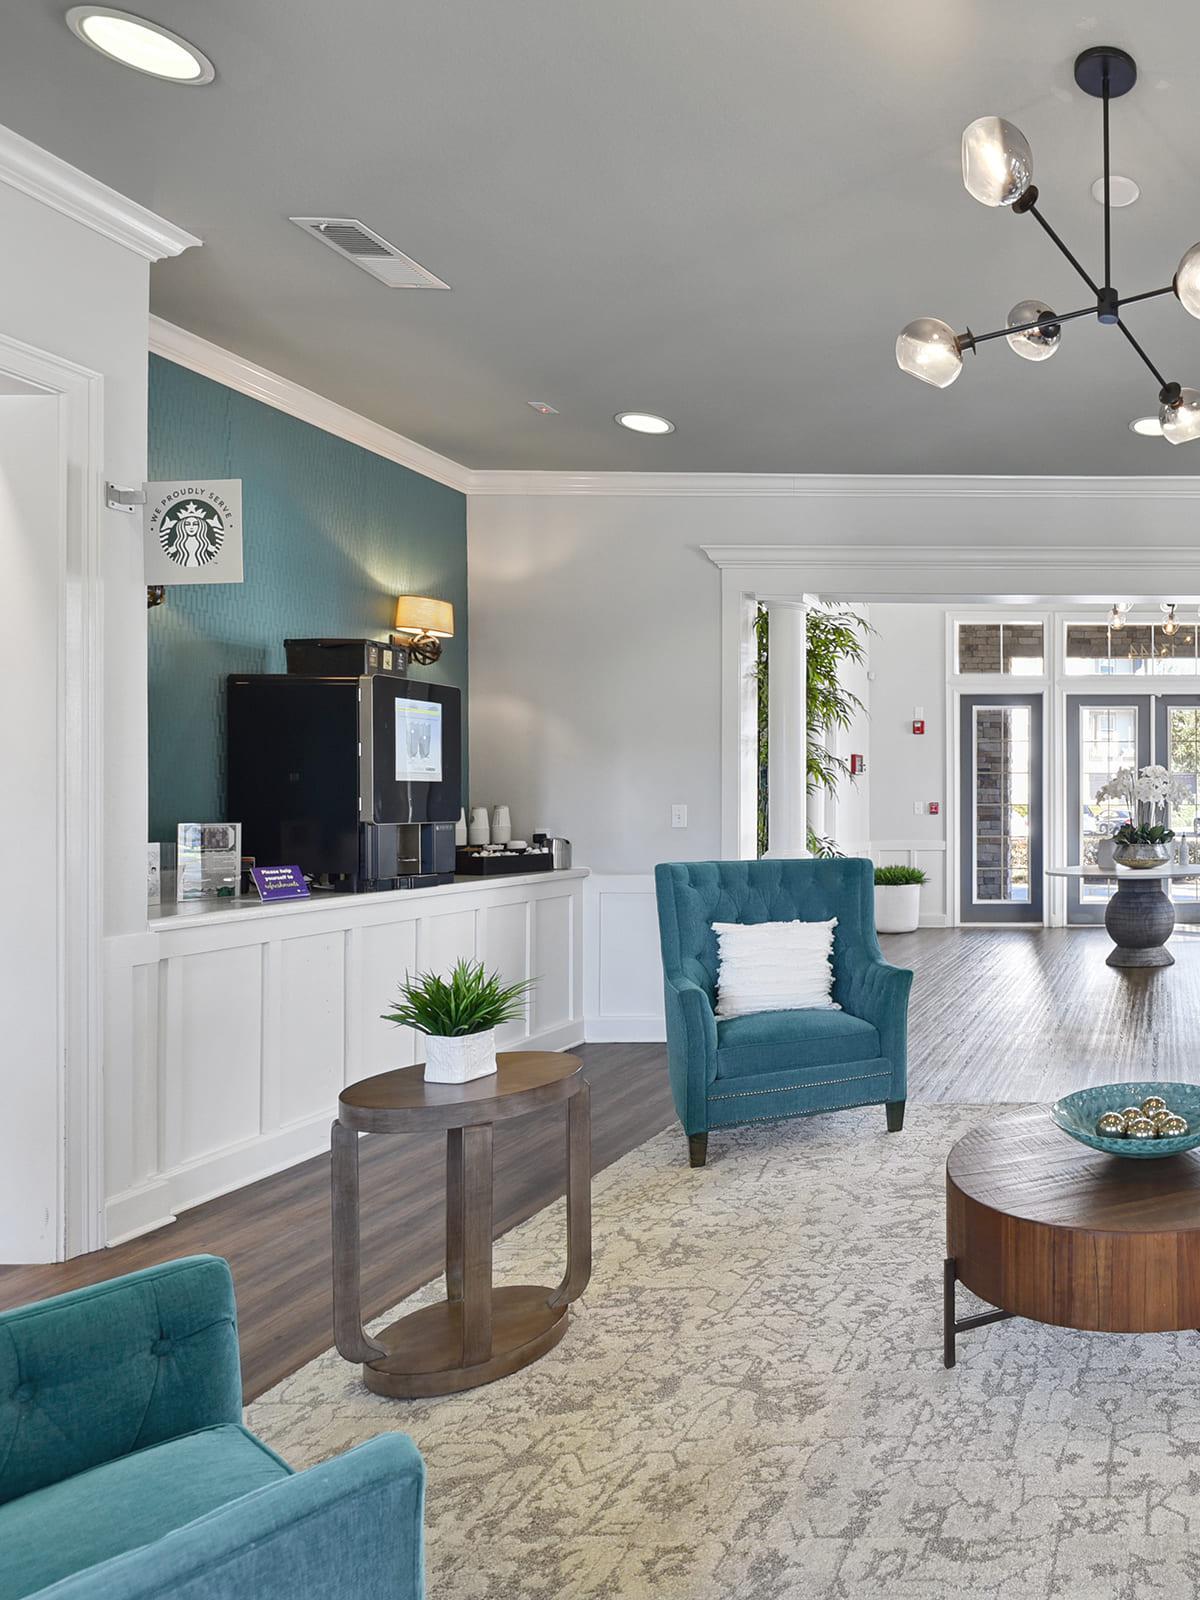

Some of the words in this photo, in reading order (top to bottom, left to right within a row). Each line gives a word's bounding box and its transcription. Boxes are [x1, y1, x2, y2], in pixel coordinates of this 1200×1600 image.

[151, 508, 162, 522] WE
[161, 488, 206, 506] PROUDLY
[208, 492, 233, 519] SERVE
